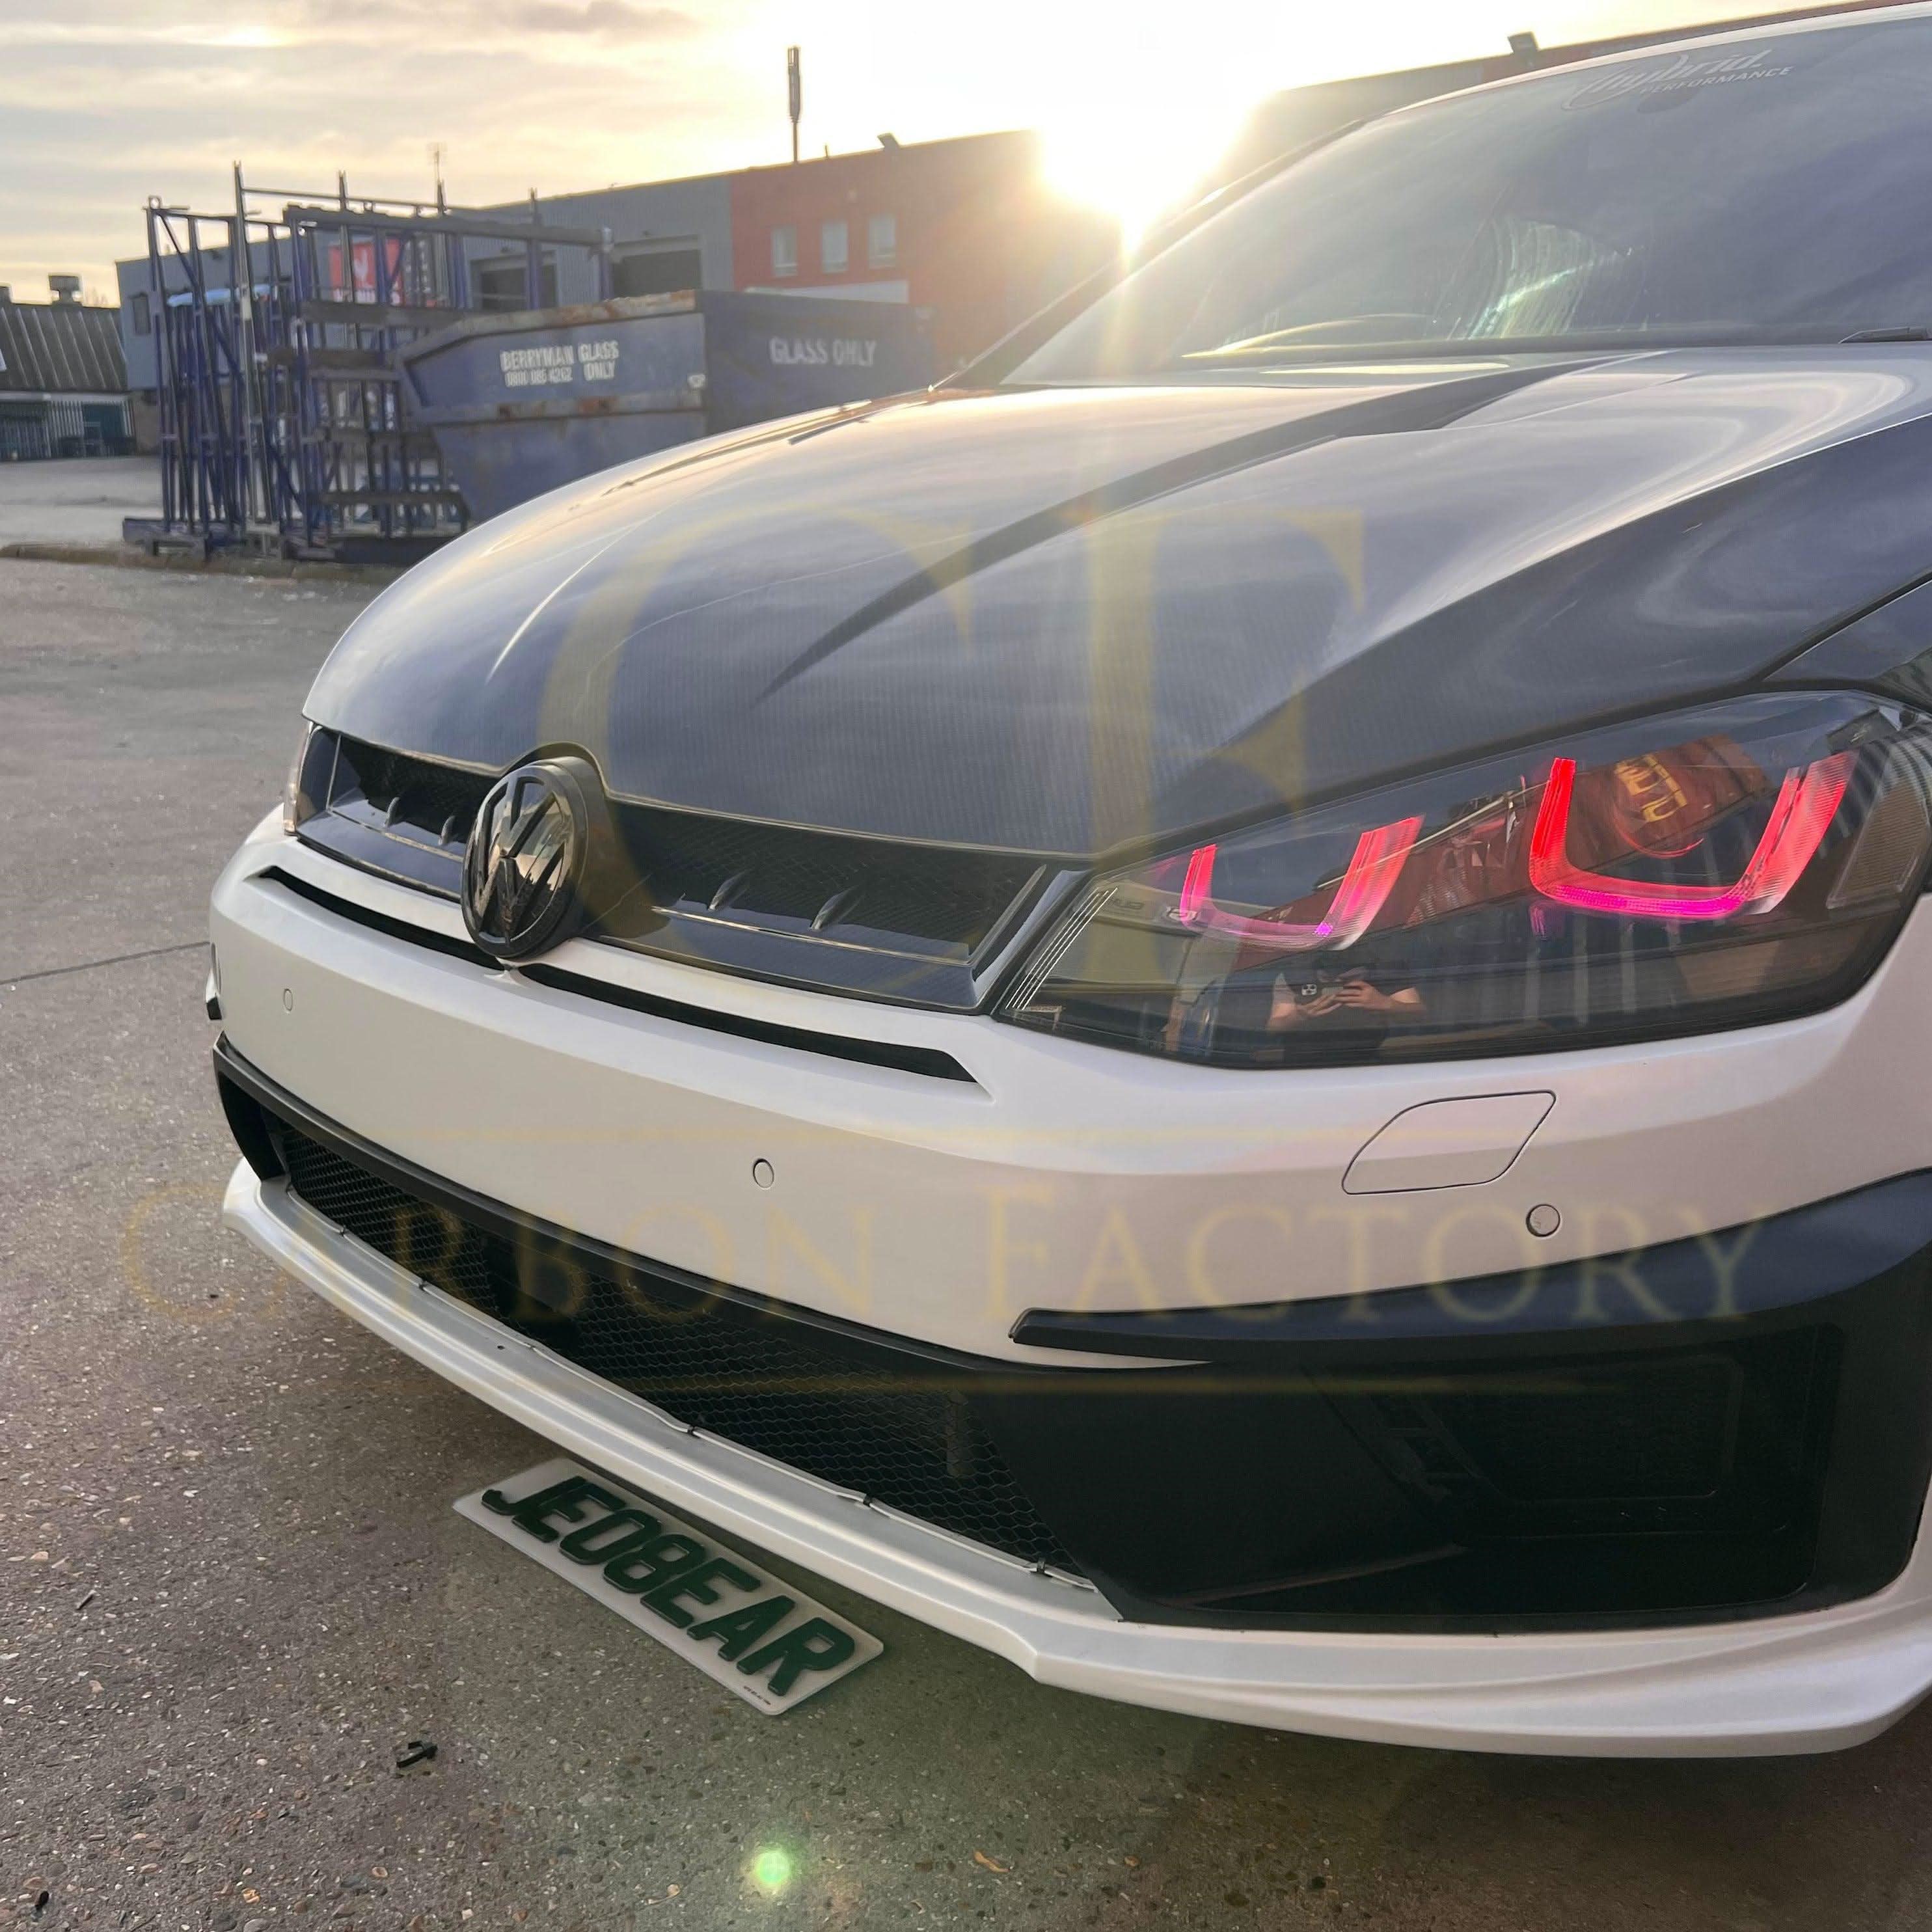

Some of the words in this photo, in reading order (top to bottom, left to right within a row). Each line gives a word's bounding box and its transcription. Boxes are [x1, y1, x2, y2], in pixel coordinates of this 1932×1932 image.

[1640, 66, 1794, 94] PERFORMANCE
[500, 346, 575, 372] BERRYMAN
[578, 340, 619, 362] GLASS
[769, 336, 829, 364] GLASS
[833, 338, 877, 367] ONLY
[584, 360, 616, 382] ONLY
